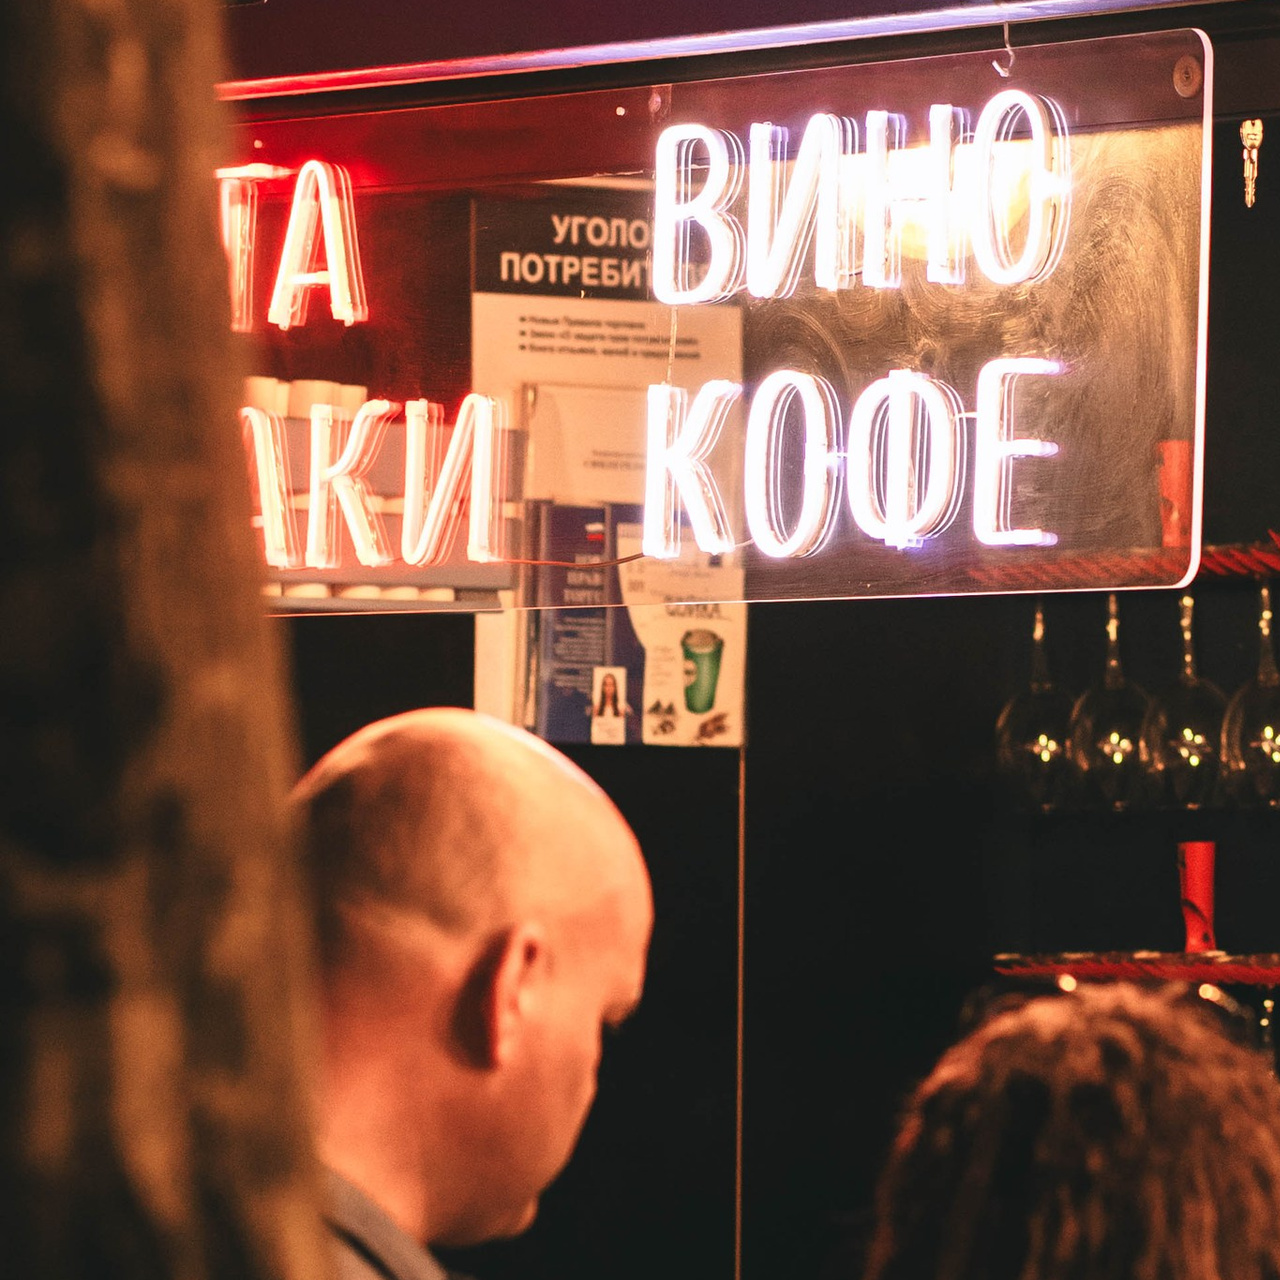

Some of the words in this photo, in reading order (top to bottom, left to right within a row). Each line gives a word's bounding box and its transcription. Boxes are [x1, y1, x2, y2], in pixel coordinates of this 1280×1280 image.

[551, 213, 652, 250] УГОЛО
[652, 88, 1070, 305] ВИНО
[641, 357, 1064, 558] КОФЕ
